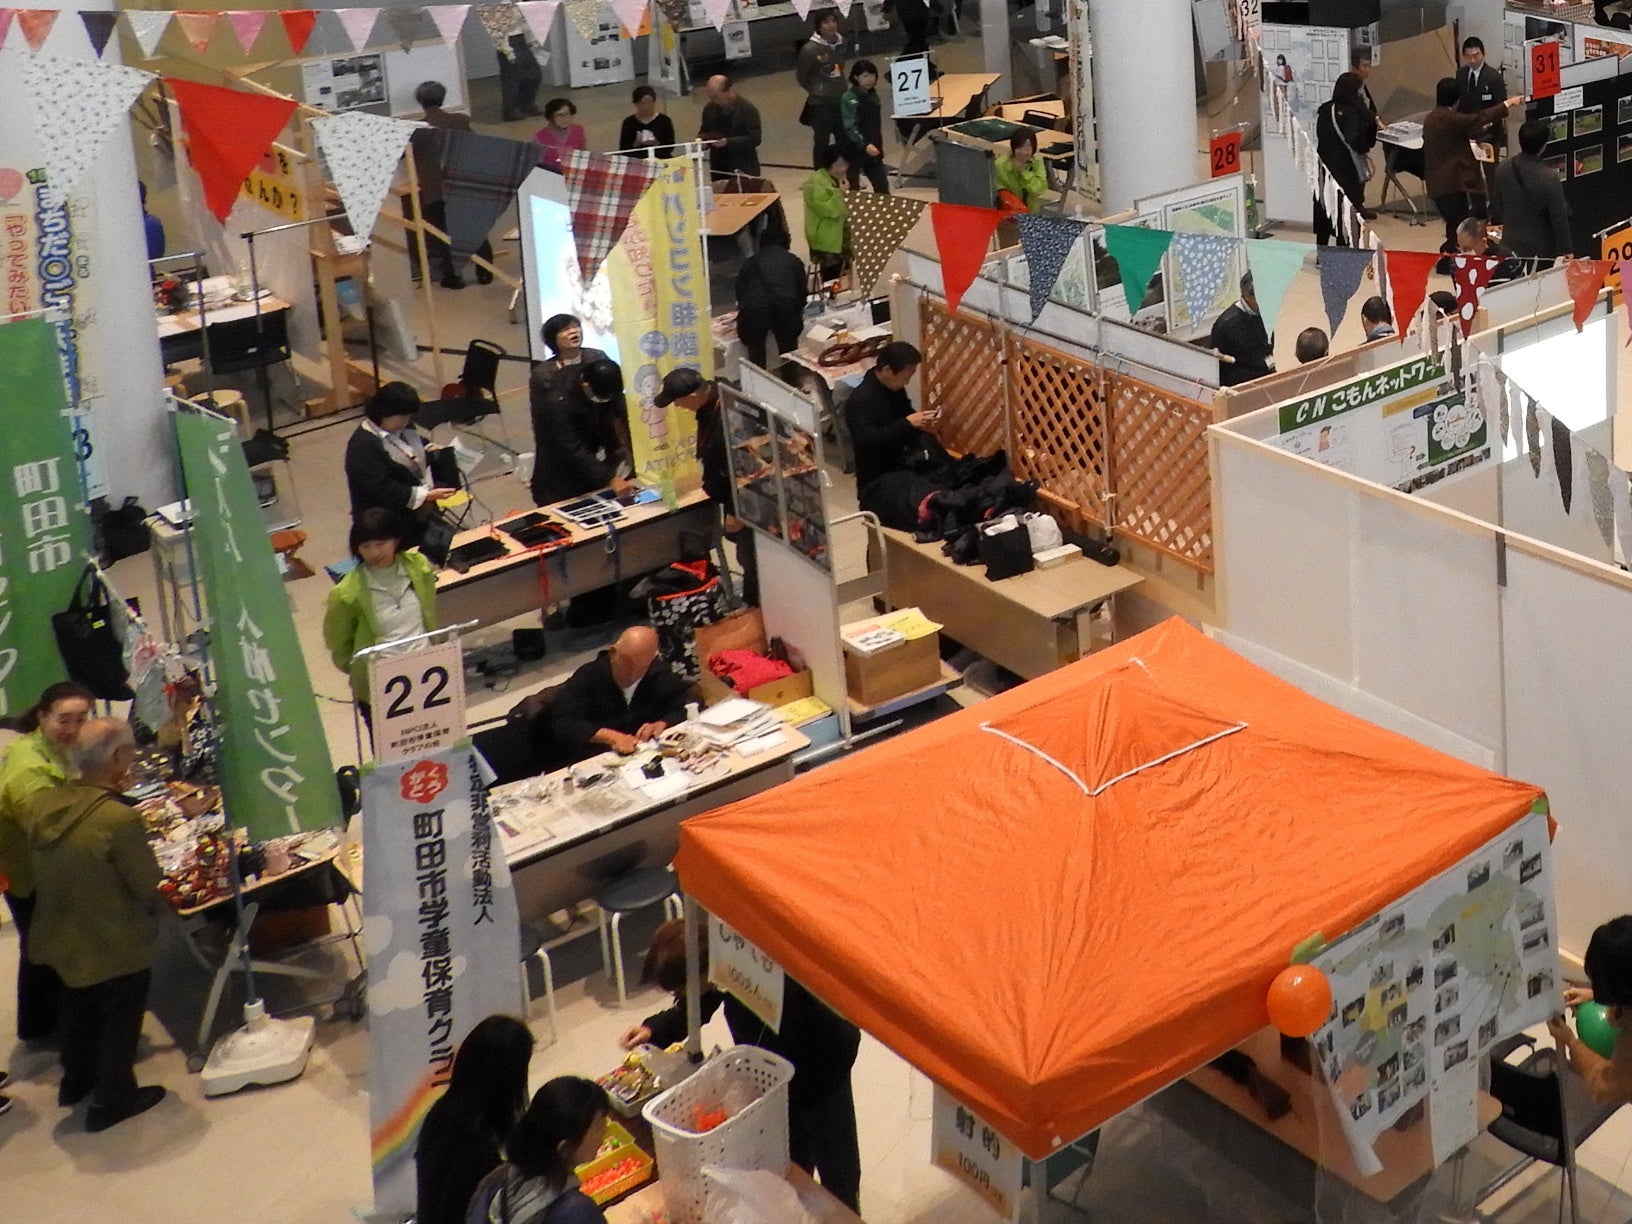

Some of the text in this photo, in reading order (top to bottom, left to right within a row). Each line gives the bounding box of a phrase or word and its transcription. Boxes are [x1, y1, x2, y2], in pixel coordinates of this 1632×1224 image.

[897, 69, 923, 92] 27
[1535, 51, 1556, 74] 31
[1213, 142, 1236, 171] 28
[661, 192, 702, 372] パソコン相談
[1331, 360, 1444, 411] こもんネットワー
[13, 457, 71, 574] 町田市
[384, 665, 451, 719] 22
